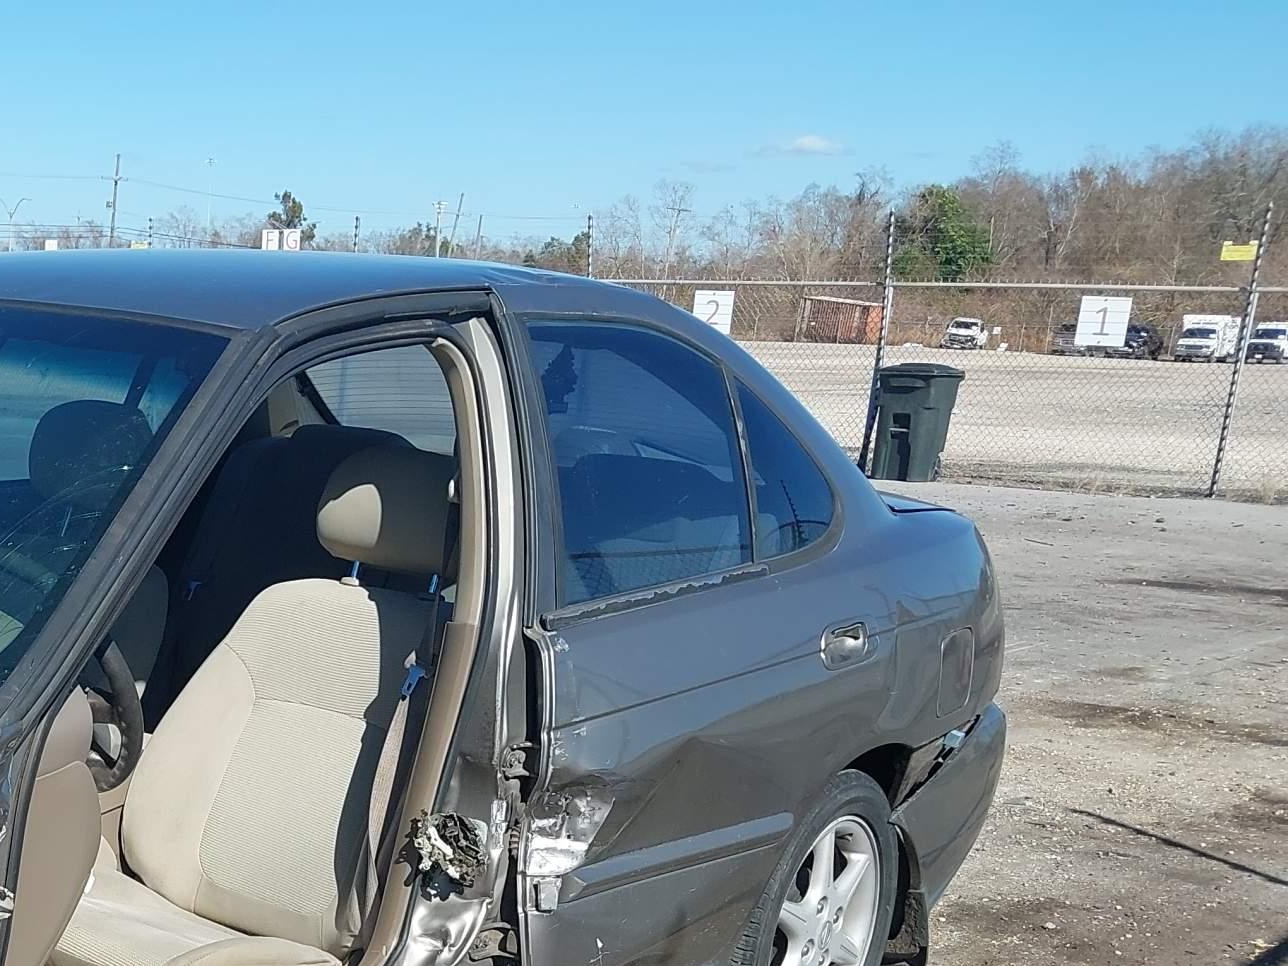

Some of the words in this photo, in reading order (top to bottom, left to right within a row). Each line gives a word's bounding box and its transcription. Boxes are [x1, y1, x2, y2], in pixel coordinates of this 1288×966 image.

[286, 230, 298, 250] G
[706, 299, 720, 325] 2
[1092, 306, 1110, 337] 1
